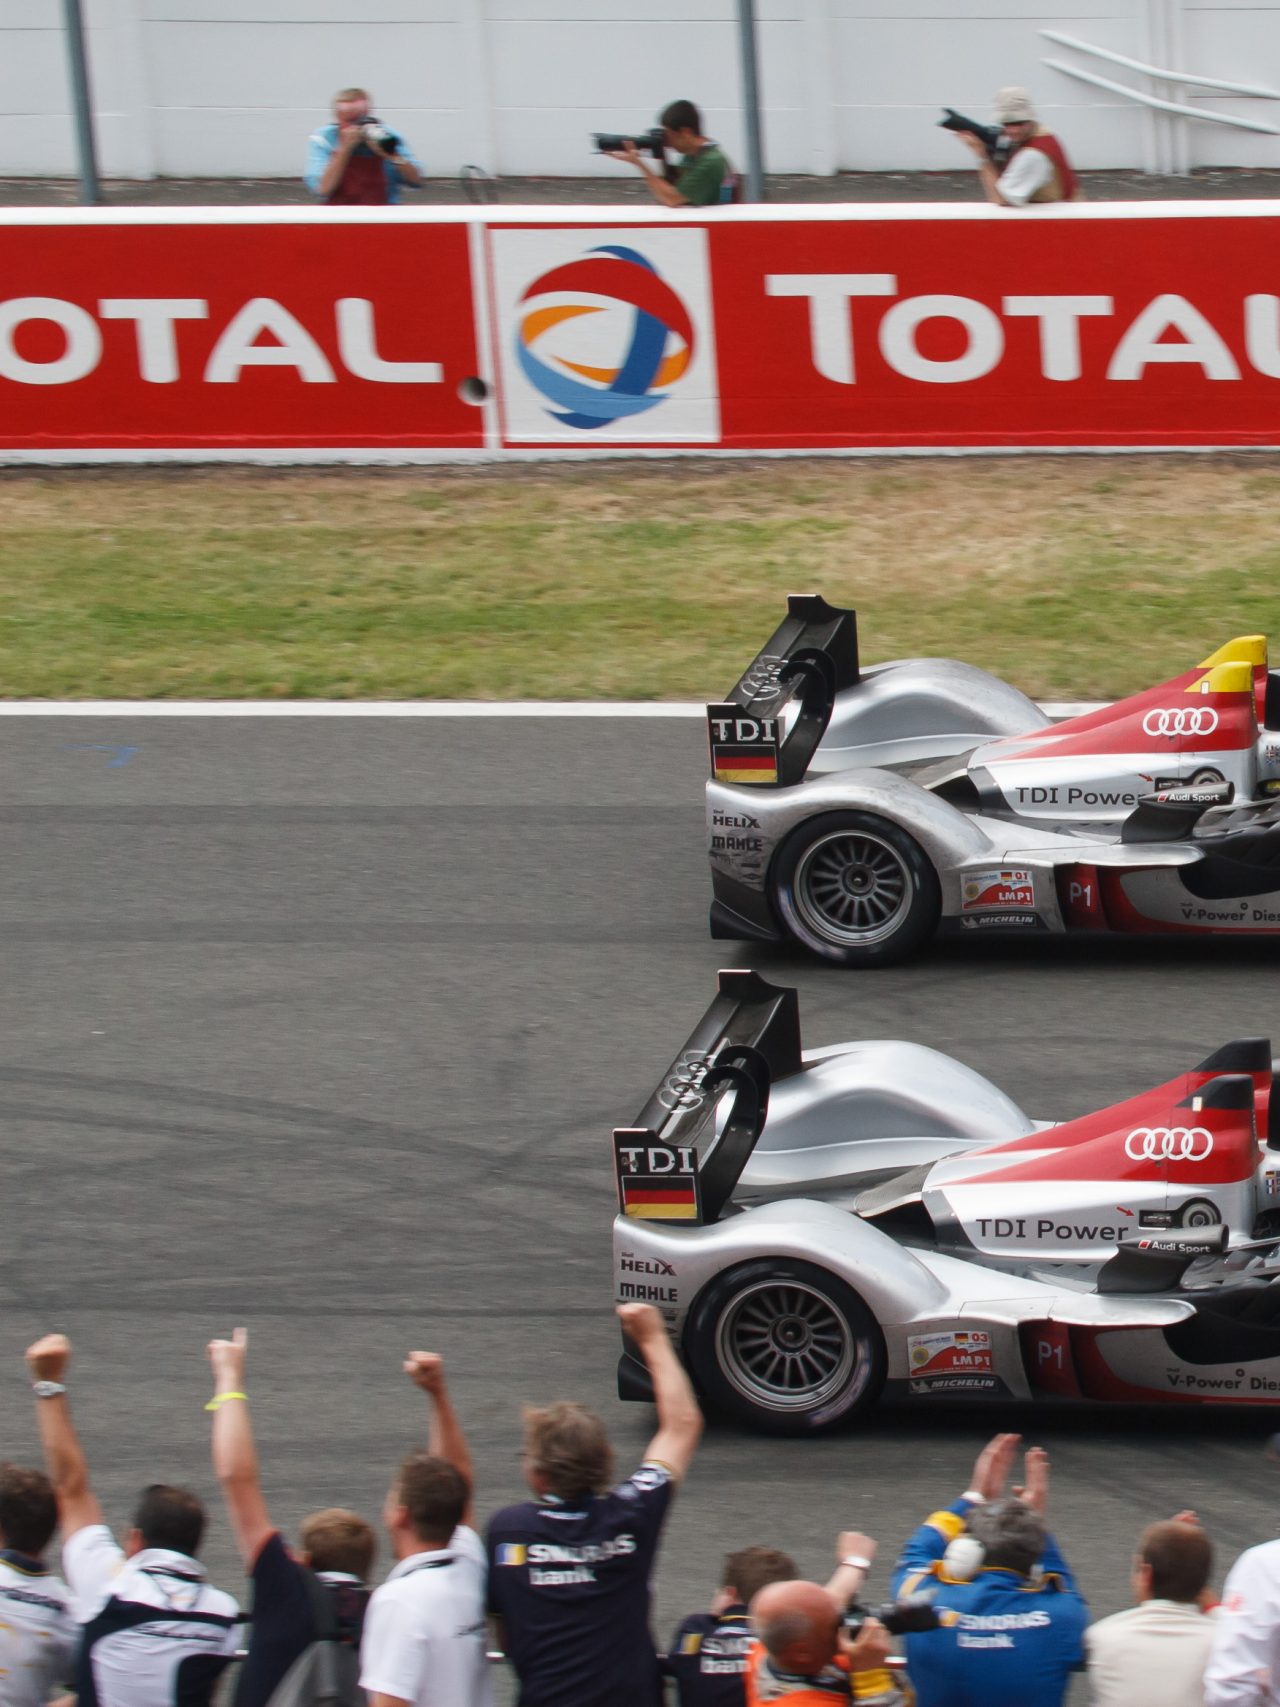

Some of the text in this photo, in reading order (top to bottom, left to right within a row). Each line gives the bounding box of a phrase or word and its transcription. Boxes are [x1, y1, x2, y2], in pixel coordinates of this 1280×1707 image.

[0, 297, 444, 385] OTAL
[711, 718, 776, 742] TDI
[1015, 787, 1059, 803] TDI
[1168, 792, 1220, 803] Audi Sport
[712, 813, 761, 829] HELIX
[711, 835, 763, 852] MAHLE
[1069, 881, 1092, 907] P1
[979, 915, 1034, 924] MICHELIN
[1181, 907, 1246, 921] V-Power
[619, 1147, 695, 1173] TDI
[975, 1218, 1129, 1241] TDI Power
[1151, 1240, 1210, 1255] Audi Sport
[620, 1257, 677, 1277] HELIX
[620, 1282, 678, 1302] MAHLE
[971, 1333, 988, 1342] 03
[1038, 1340, 1063, 1369] P1
[931, 1379, 995, 1388] MICHELIN
[1167, 1373, 1243, 1390] V-Power
